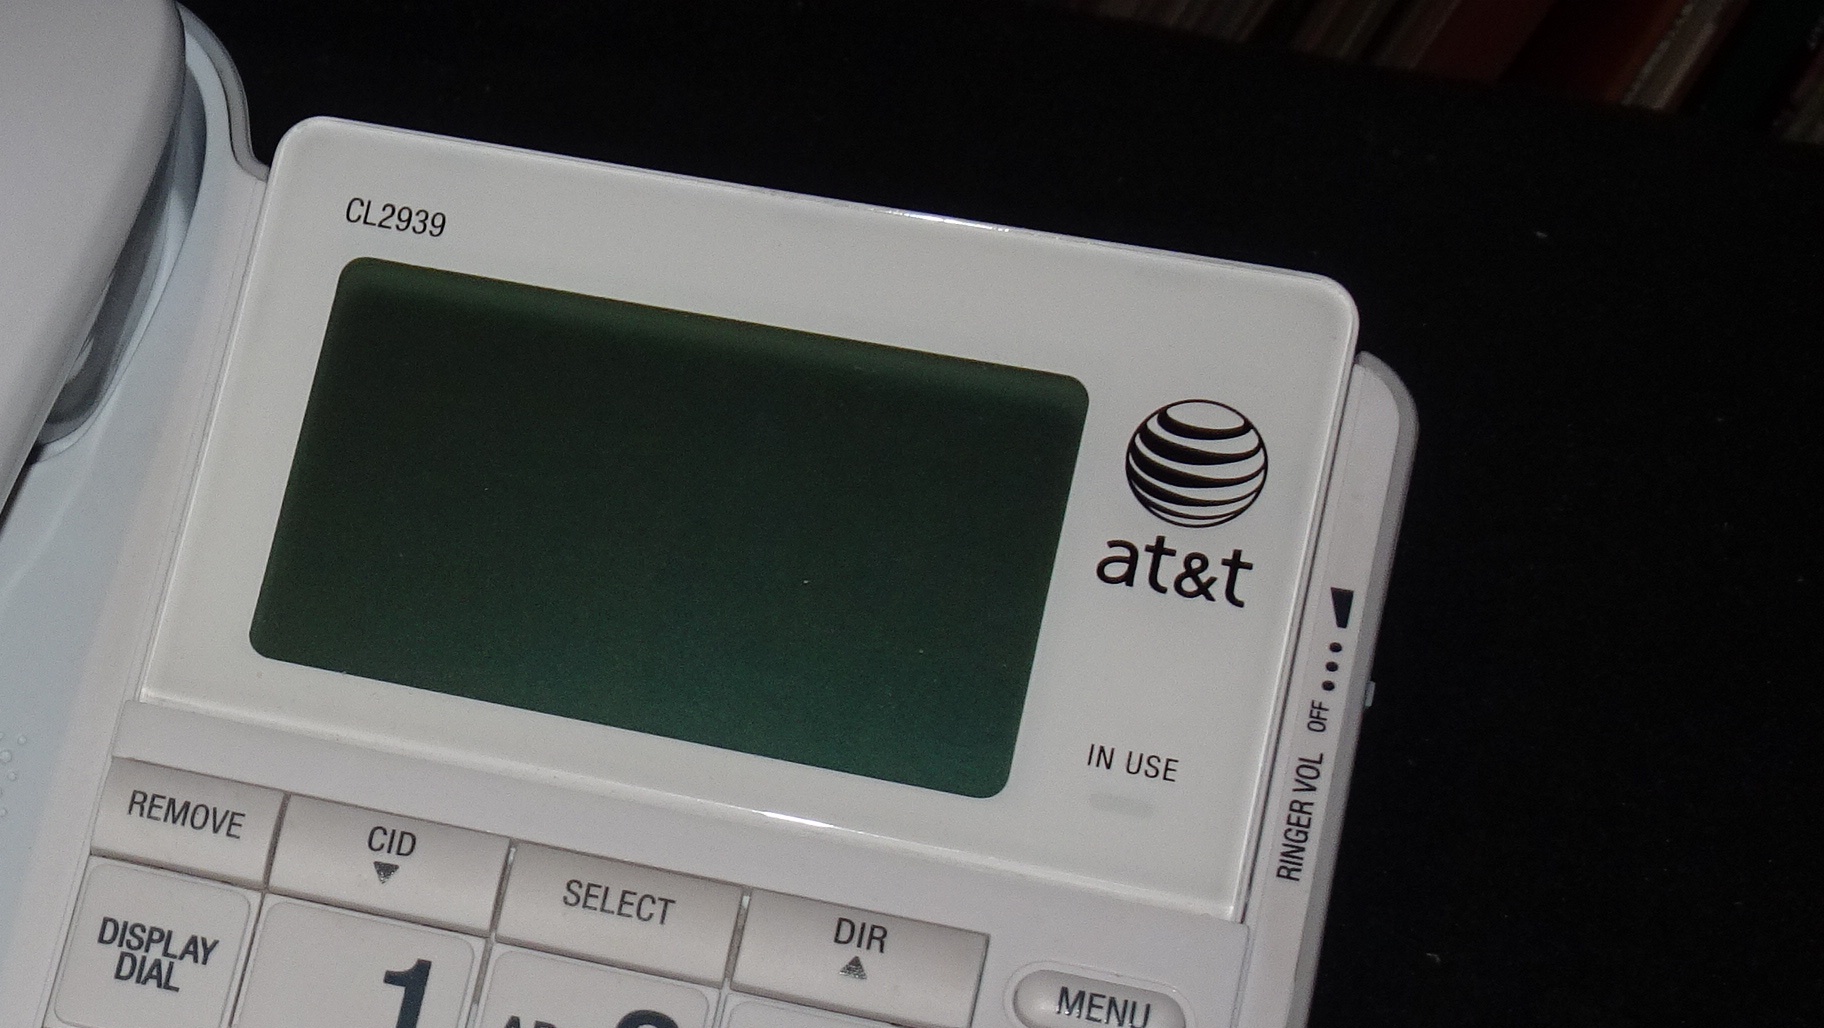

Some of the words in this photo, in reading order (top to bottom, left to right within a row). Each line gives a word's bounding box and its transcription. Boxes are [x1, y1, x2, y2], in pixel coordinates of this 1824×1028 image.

[345, 197, 447, 238] CL2939
[1096, 535, 1254, 609] at&t
[1306, 699, 1330, 733] OFF
[1087, 743, 1115, 771] IN
[1125, 750, 1179, 783] USE
[1292, 752, 1324, 793] VOL
[127, 789, 246, 840] REMOVE
[367, 825, 417, 857] CID
[1275, 799, 1315, 882] RINGER
[562, 878, 677, 925] SELECT
[97, 916, 220, 966] DISPLAY
[833, 916, 889, 954] DIR
[113, 951, 180, 993] DIAL
